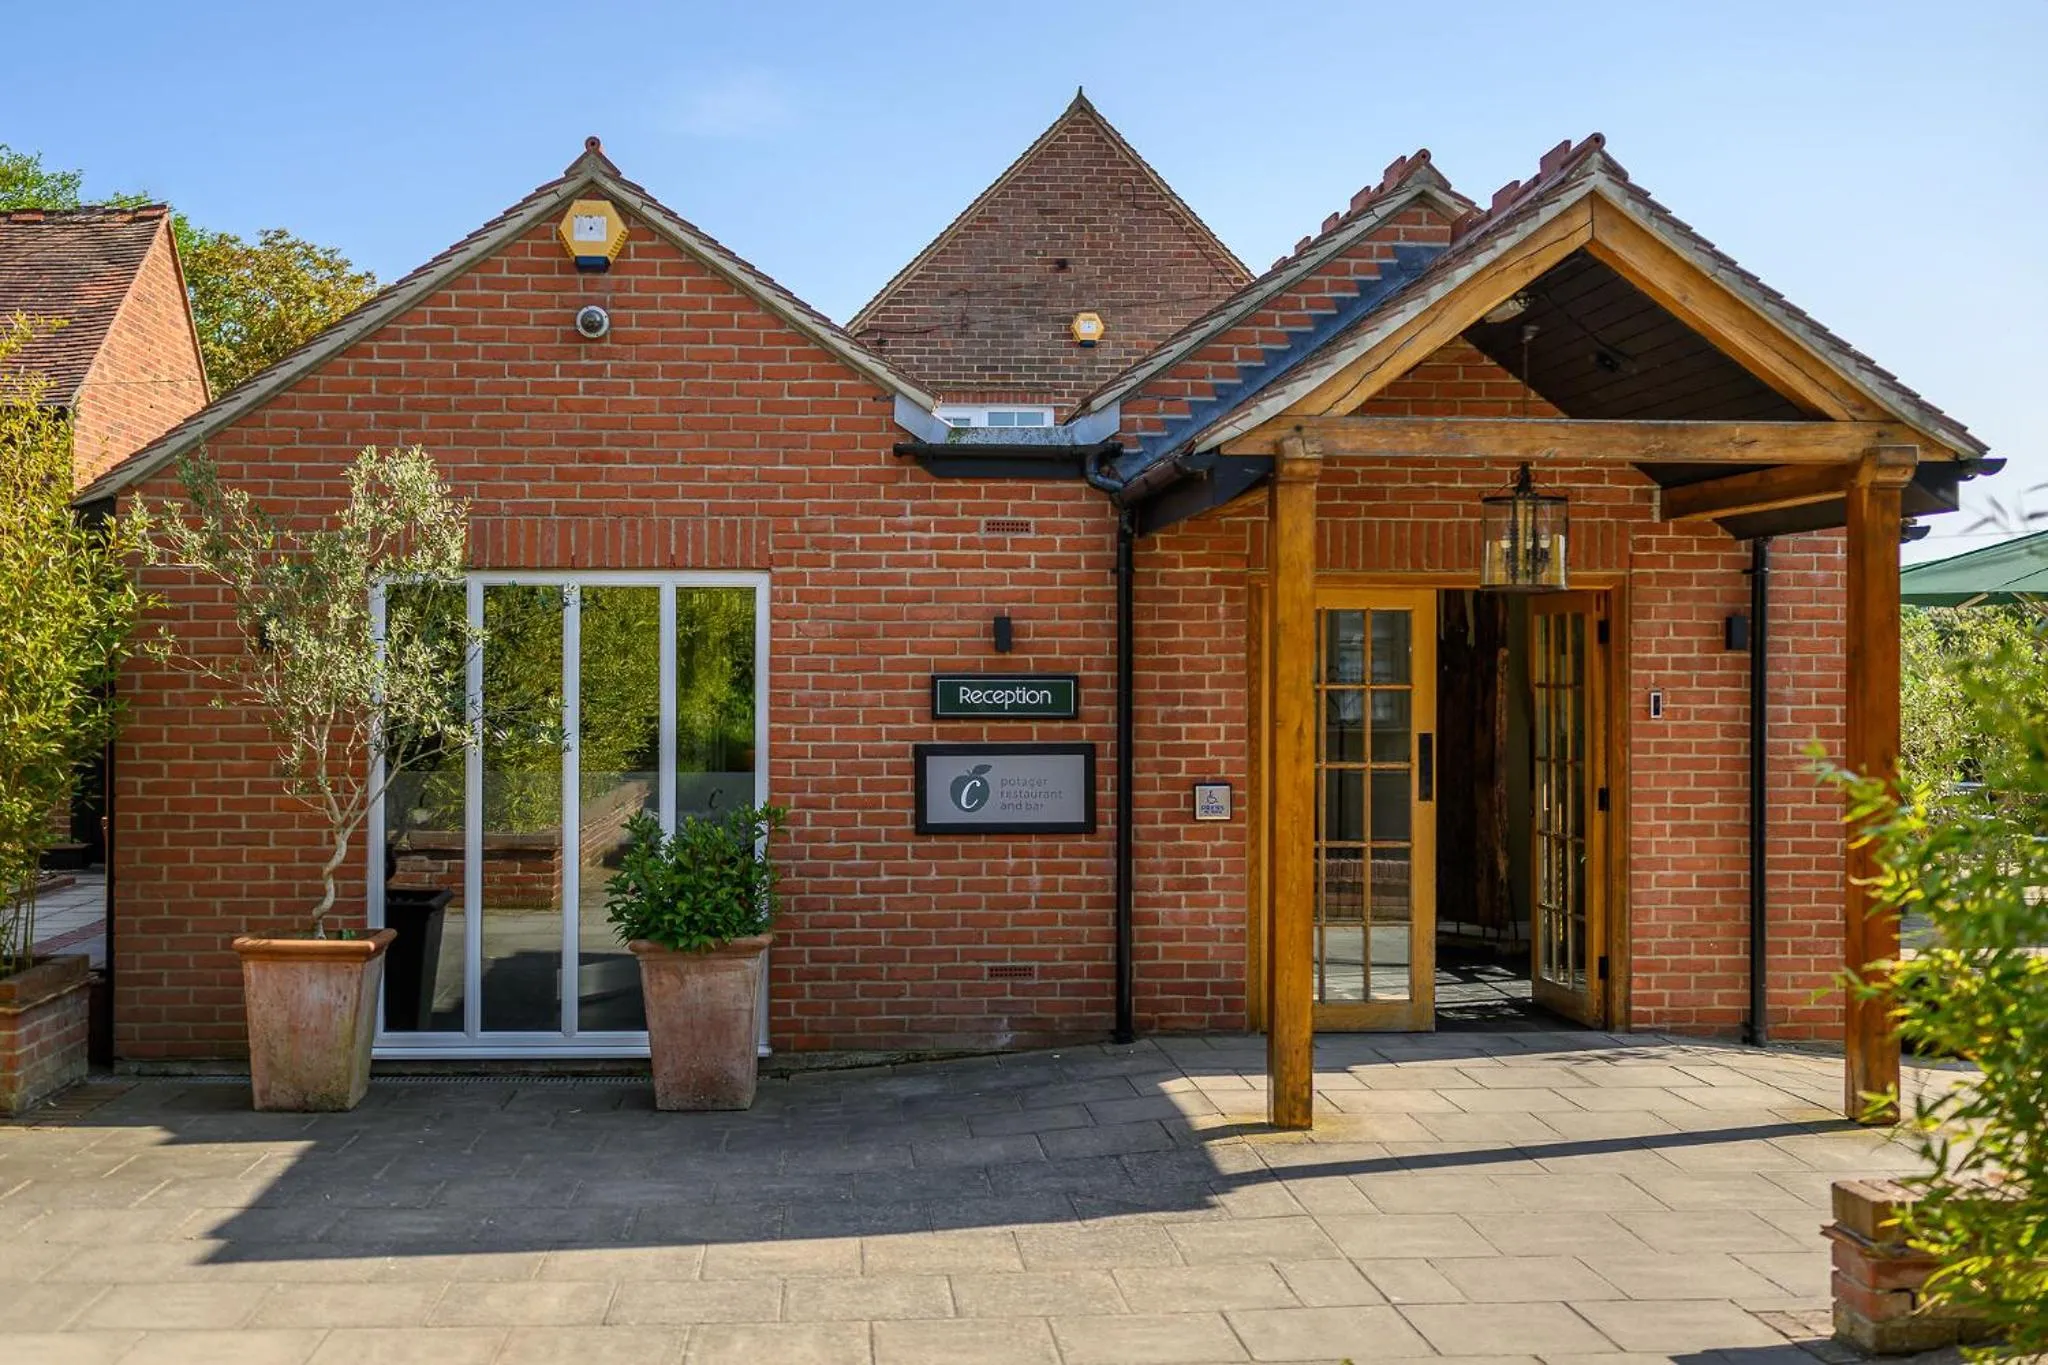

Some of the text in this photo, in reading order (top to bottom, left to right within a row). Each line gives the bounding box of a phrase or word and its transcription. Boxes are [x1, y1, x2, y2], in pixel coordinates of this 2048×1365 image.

[959, 686, 1052, 710] Reception
[1000, 776, 1049, 788] potager
[1000, 789, 1063, 800] restaurant
[1000, 802, 1045, 811] and bar
